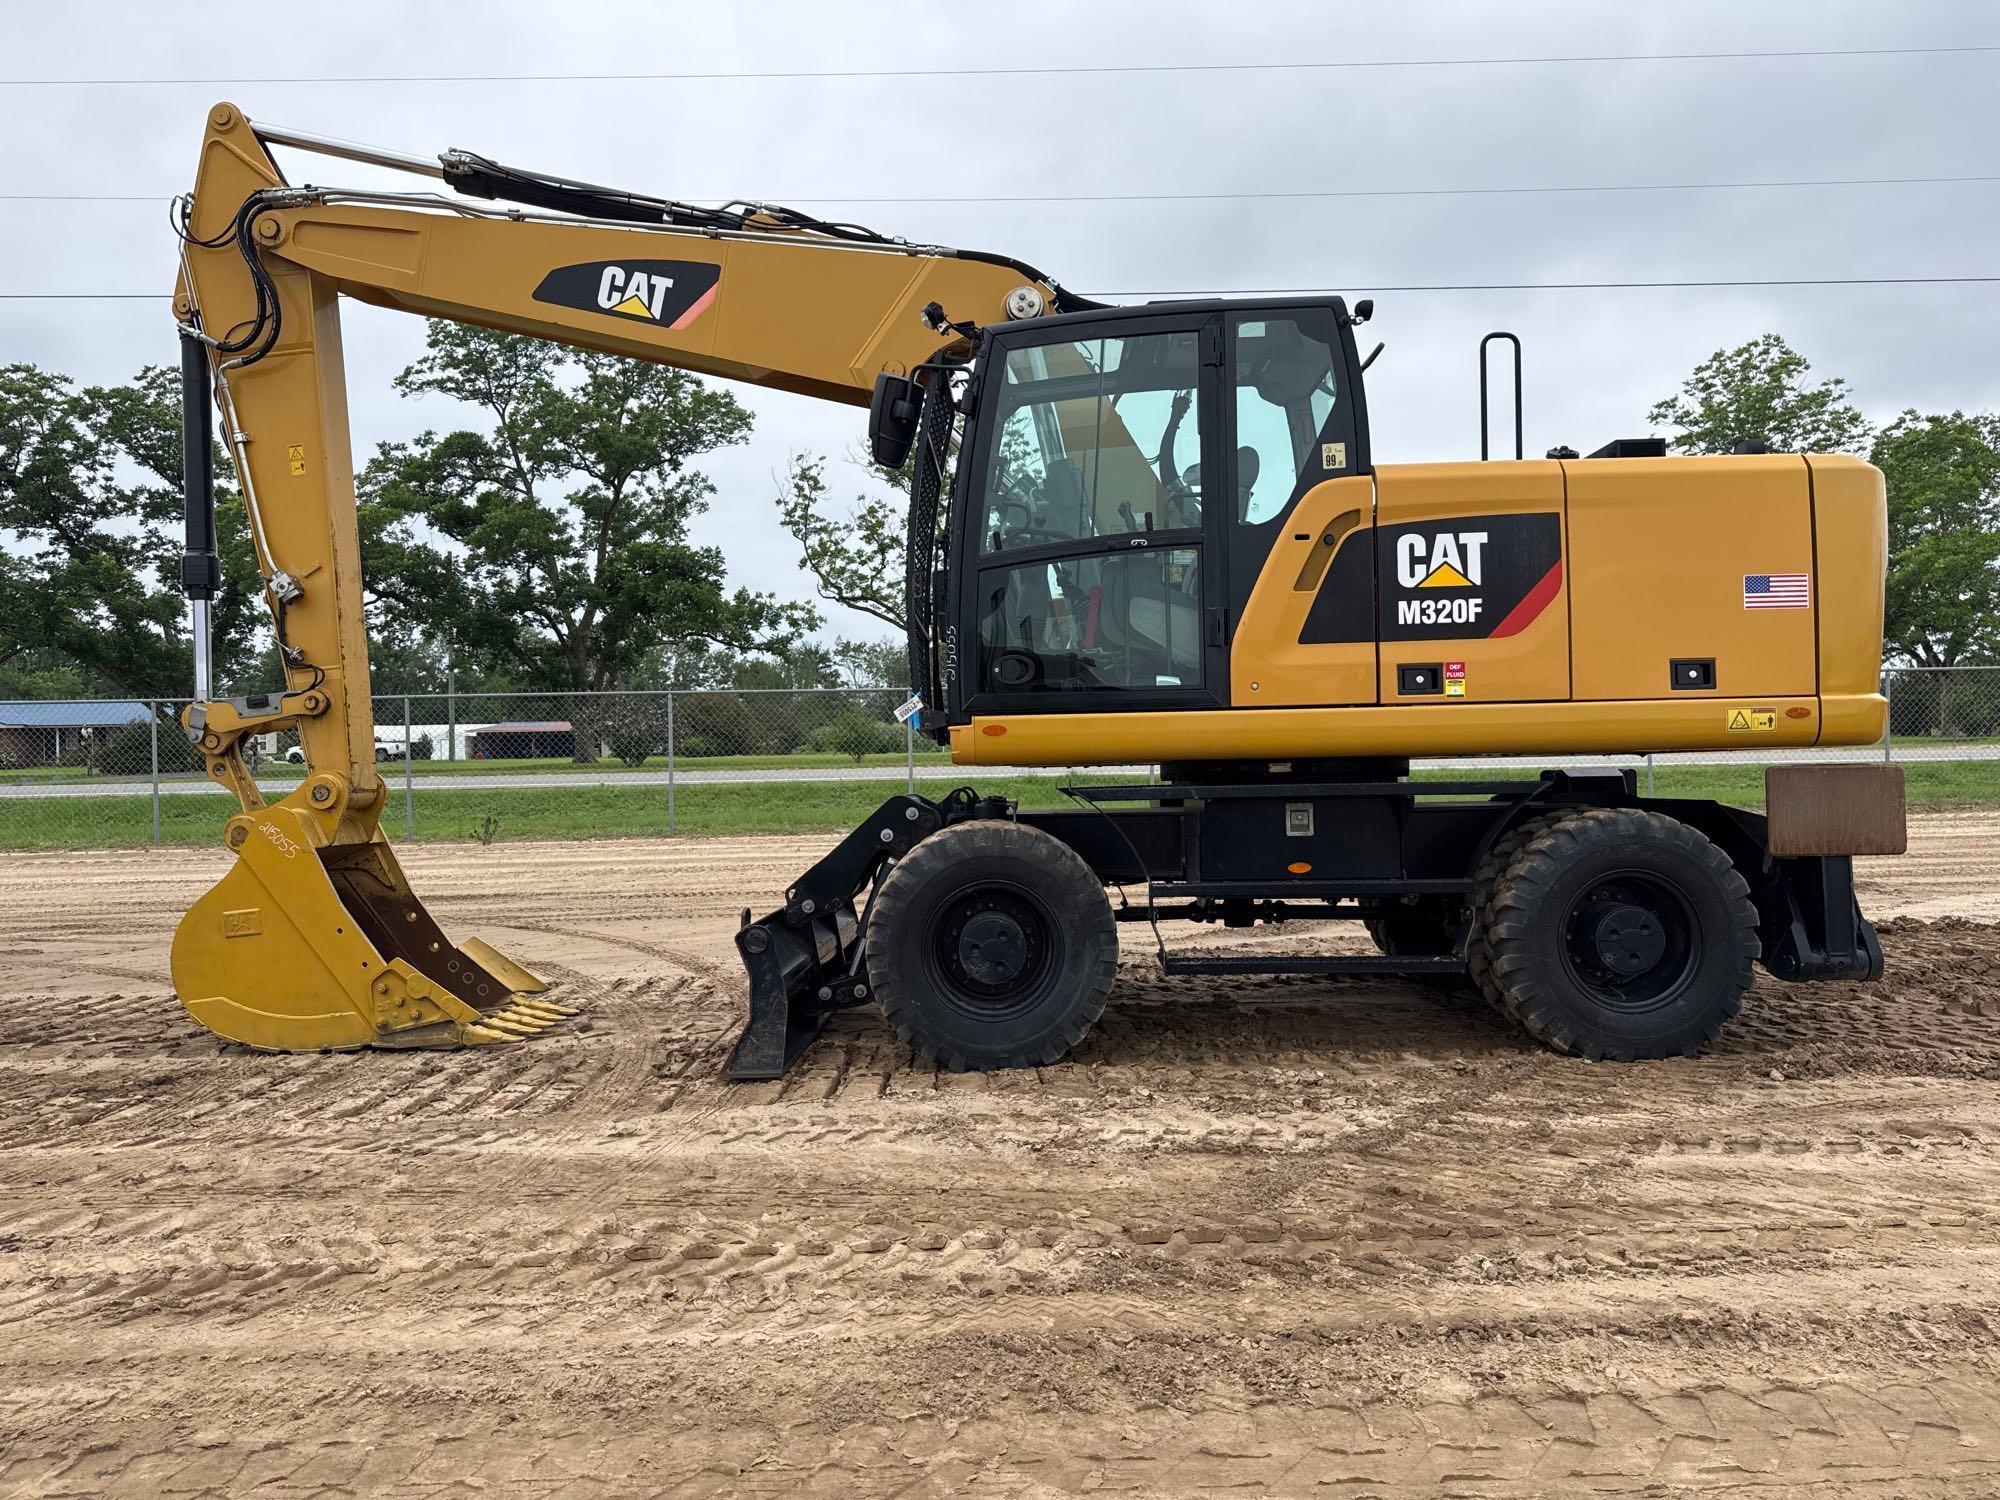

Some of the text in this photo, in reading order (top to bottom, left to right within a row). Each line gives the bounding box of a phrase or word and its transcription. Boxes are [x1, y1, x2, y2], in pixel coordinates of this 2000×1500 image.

[597, 266, 674, 320] CAT
[1325, 454, 1336, 466] 99
[1396, 531, 1488, 588] CAT
[1398, 598, 1482, 624] M320F
[946, 625, 957, 681] 215055
[258, 821, 300, 858] 215055
